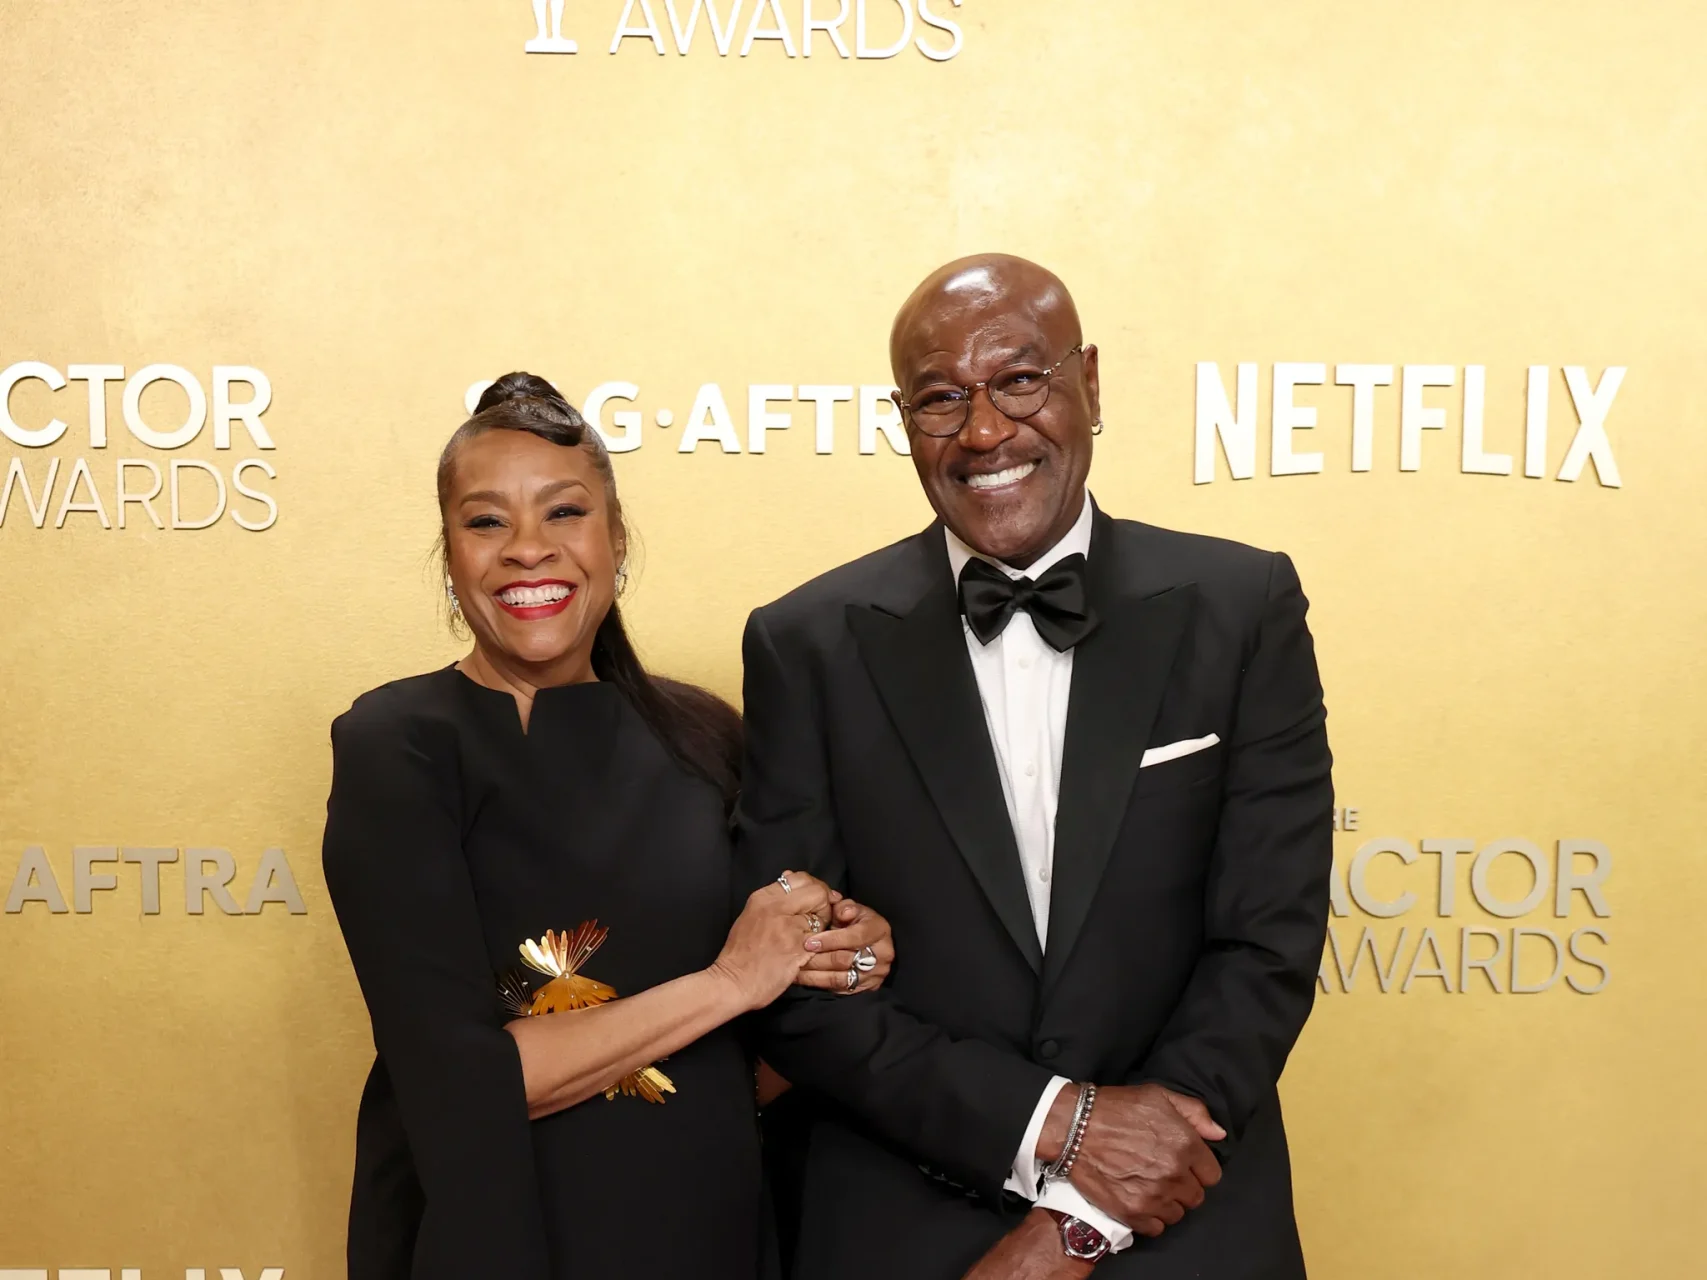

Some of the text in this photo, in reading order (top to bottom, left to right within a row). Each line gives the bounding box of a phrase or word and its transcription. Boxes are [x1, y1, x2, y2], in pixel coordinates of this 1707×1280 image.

[608, 0, 963, 61] AWARDS
[0, 361, 277, 450] CTOR
[464, 379, 912, 456] G·AFTR
[1194, 362, 1629, 489] NETFLIX
[5, 846, 308, 915] AFTRA
